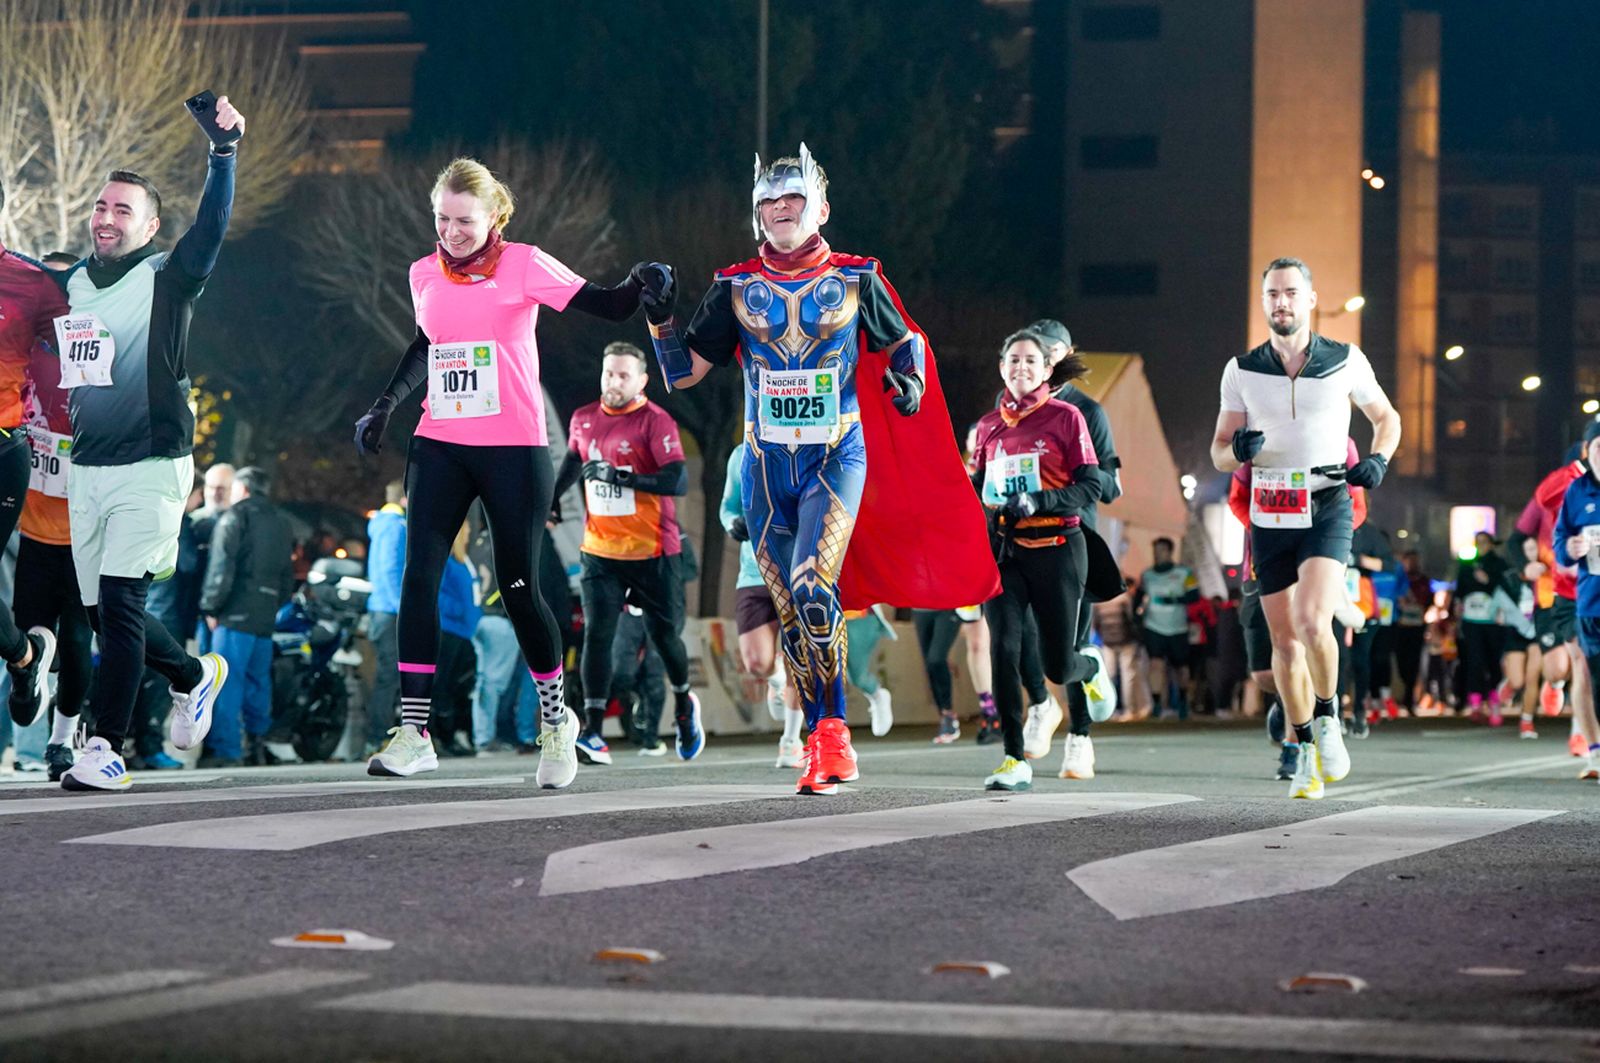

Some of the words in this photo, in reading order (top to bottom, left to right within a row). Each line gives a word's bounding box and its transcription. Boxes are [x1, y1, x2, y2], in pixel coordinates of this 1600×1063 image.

[69, 340, 100, 362] 4115
[457, 351, 466, 359] DE
[436, 361, 445, 369] SAN
[441, 369, 478, 393] 1071
[772, 379, 796, 387] NOCHE
[798, 378, 808, 386] DE
[766, 387, 779, 396] SAN
[770, 396, 825, 419] 9025
[31, 450, 60, 475] 5110
[594, 484, 622, 499] 4379
